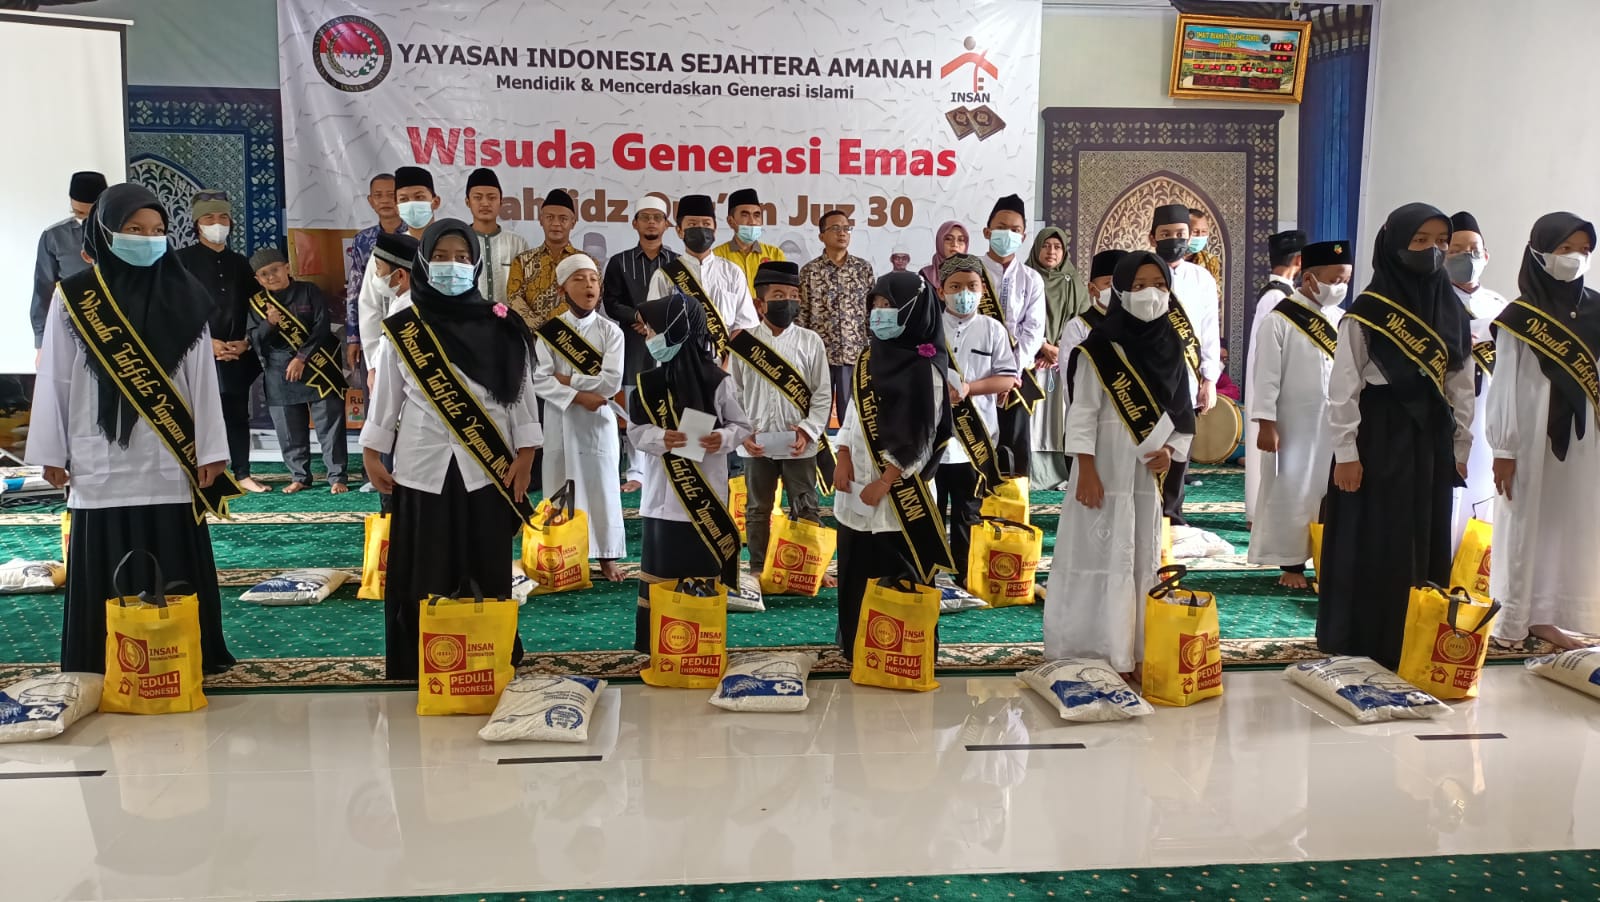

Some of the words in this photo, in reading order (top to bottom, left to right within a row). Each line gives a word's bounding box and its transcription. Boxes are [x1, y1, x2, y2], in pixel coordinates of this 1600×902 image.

[398, 44, 517, 67] YAYASAN
[526, 48, 674, 72] INDONESIA
[681, 53, 819, 77] SEJAHTERA
[828, 58, 932, 79] AMANAH
[496, 75, 575, 91] Mendidik
[581, 78, 594, 92] &
[600, 78, 722, 97] Mencerdaskan
[727, 82, 801, 98] Generasi
[805, 83, 854, 99] islami
[951, 92, 990, 103] INSAN
[406, 126, 595, 169] Wisuda
[612, 132, 821, 175] Generasi
[838, 139, 957, 177] Emas
[501, 187, 629, 223] ahidz
[867, 195, 913, 227] 30
[555, 330, 589, 364] Wisuda
[1386, 312, 1430, 354] Wisuda
[1525, 317, 1572, 357] Wisuda
[78, 289, 122, 344] Wisuda
[150, 393, 186, 444] Yayasan
[750, 345, 783, 380] Wisuda
[399, 321, 434, 369] Wisuda
[462, 415, 494, 463] Yayasan
[491, 454, 510, 481] INS
[1111, 371, 1148, 422] Wisuda
[898, 486, 927, 522] INSAN
[149, 646, 179, 656] INSAN
[467, 642, 494, 652] INSAN
[681, 656, 720, 666] PEDULI
[450, 671, 493, 686] PEDULI
[451, 684, 493, 694] INDONESIA
[1455, 669, 1477, 680] PED
